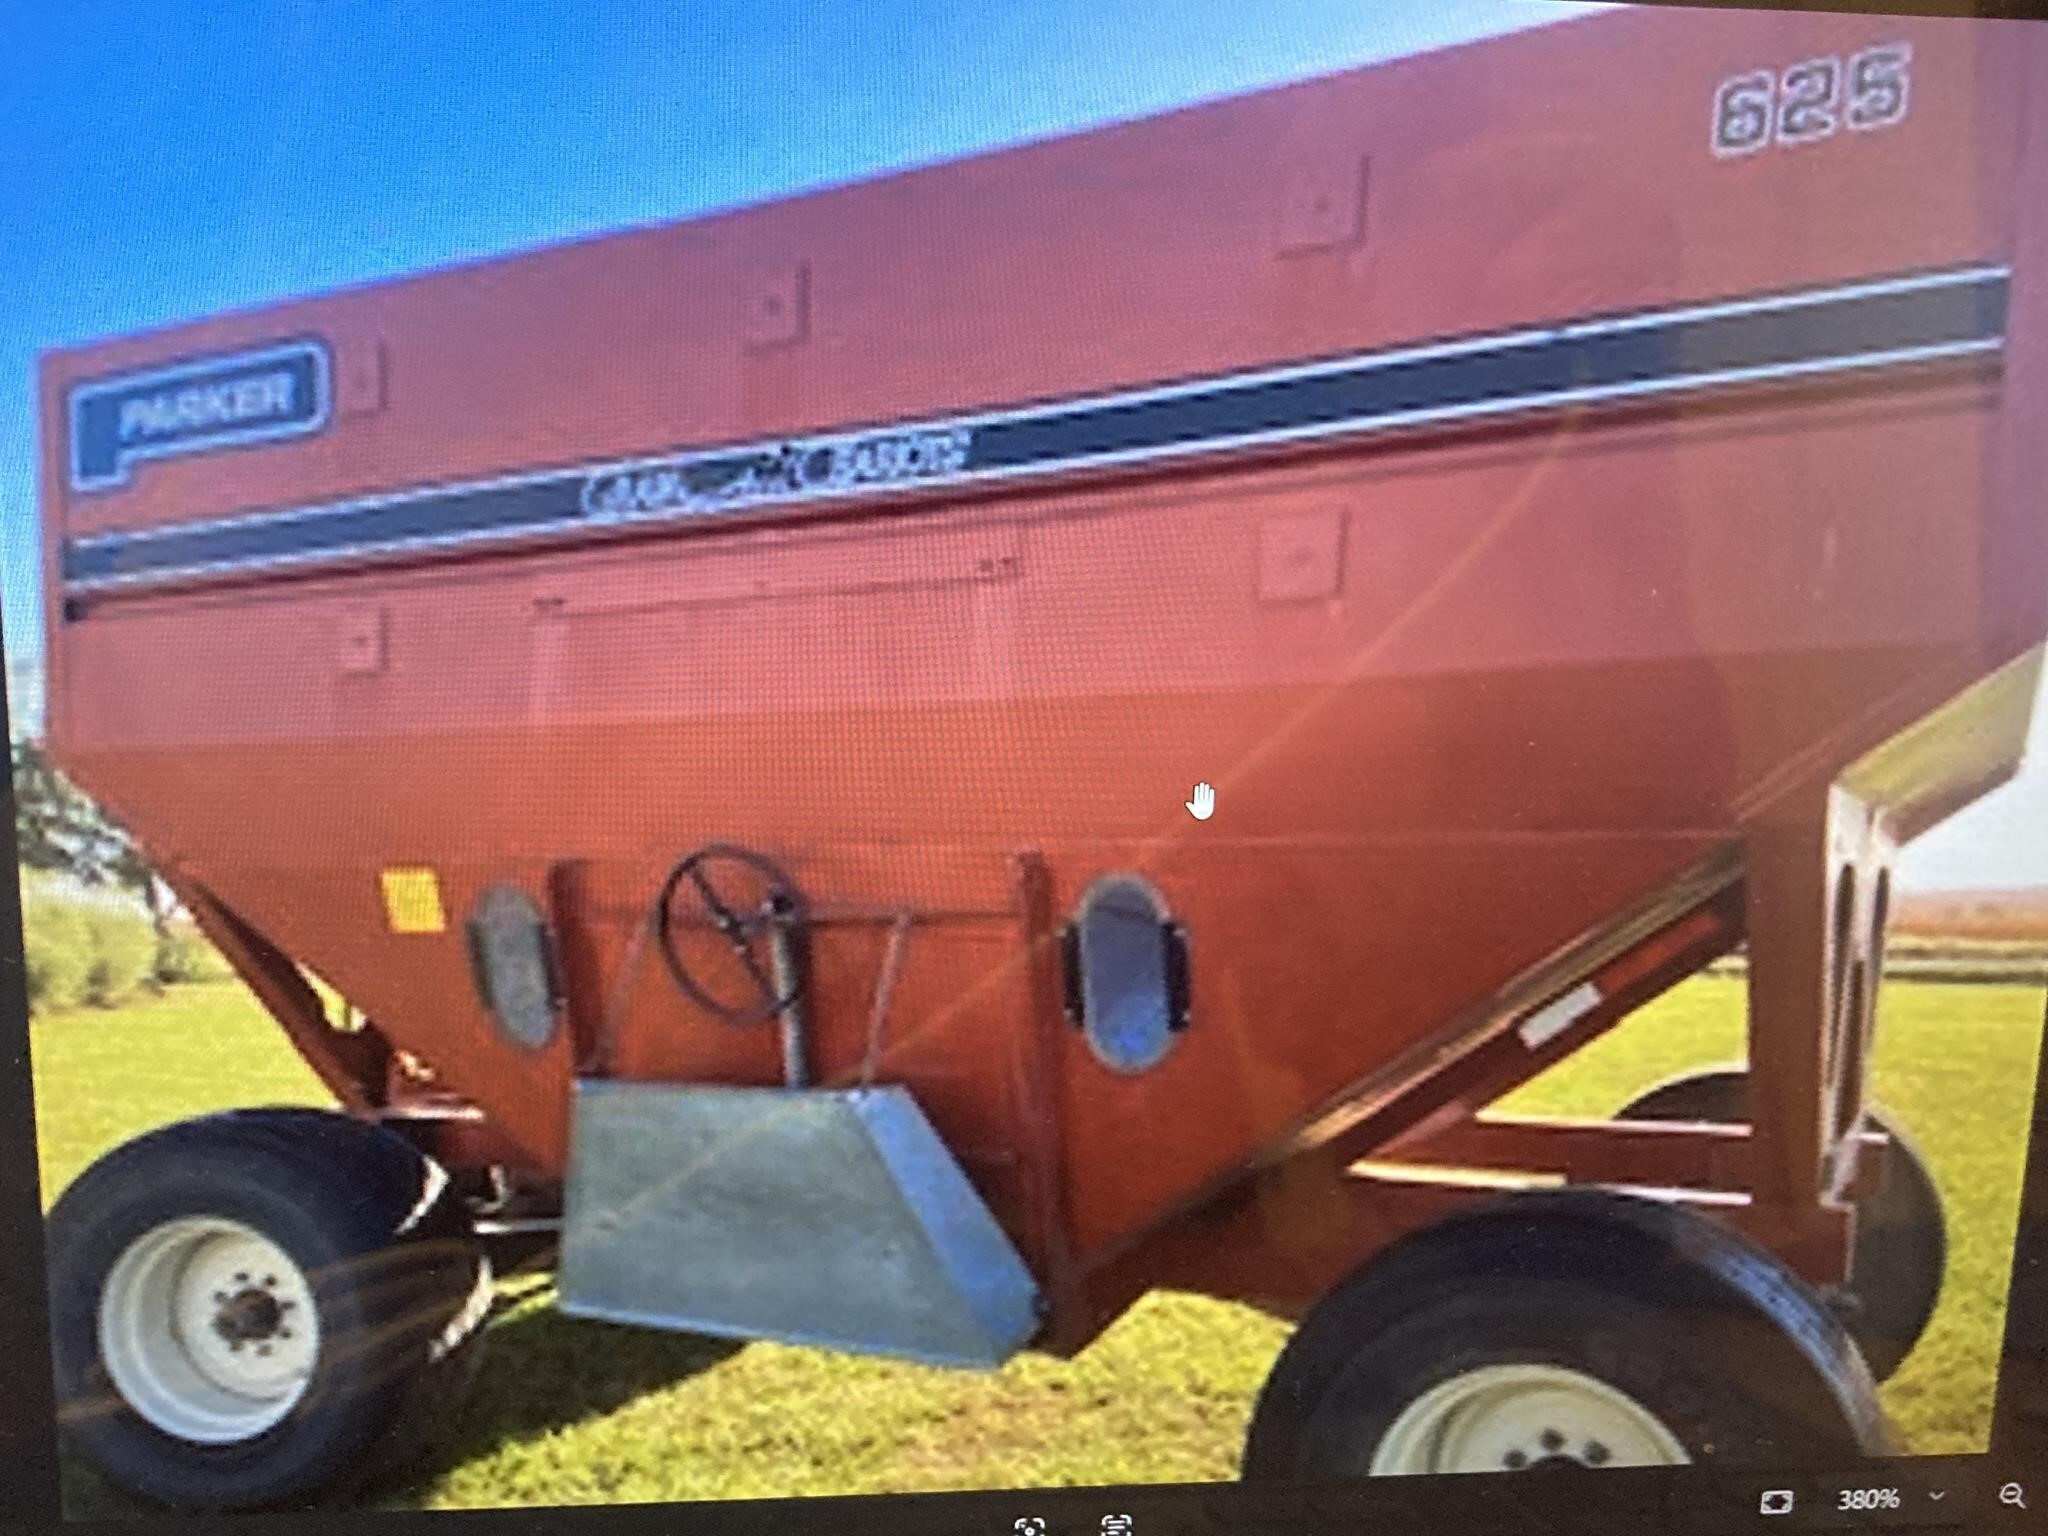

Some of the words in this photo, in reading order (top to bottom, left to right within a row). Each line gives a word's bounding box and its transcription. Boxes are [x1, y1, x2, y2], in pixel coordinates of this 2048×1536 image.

[1711, 43, 1912, 157] 625
[118, 371, 295, 441] PARKER
[1837, 1488, 1900, 1511] 380%
